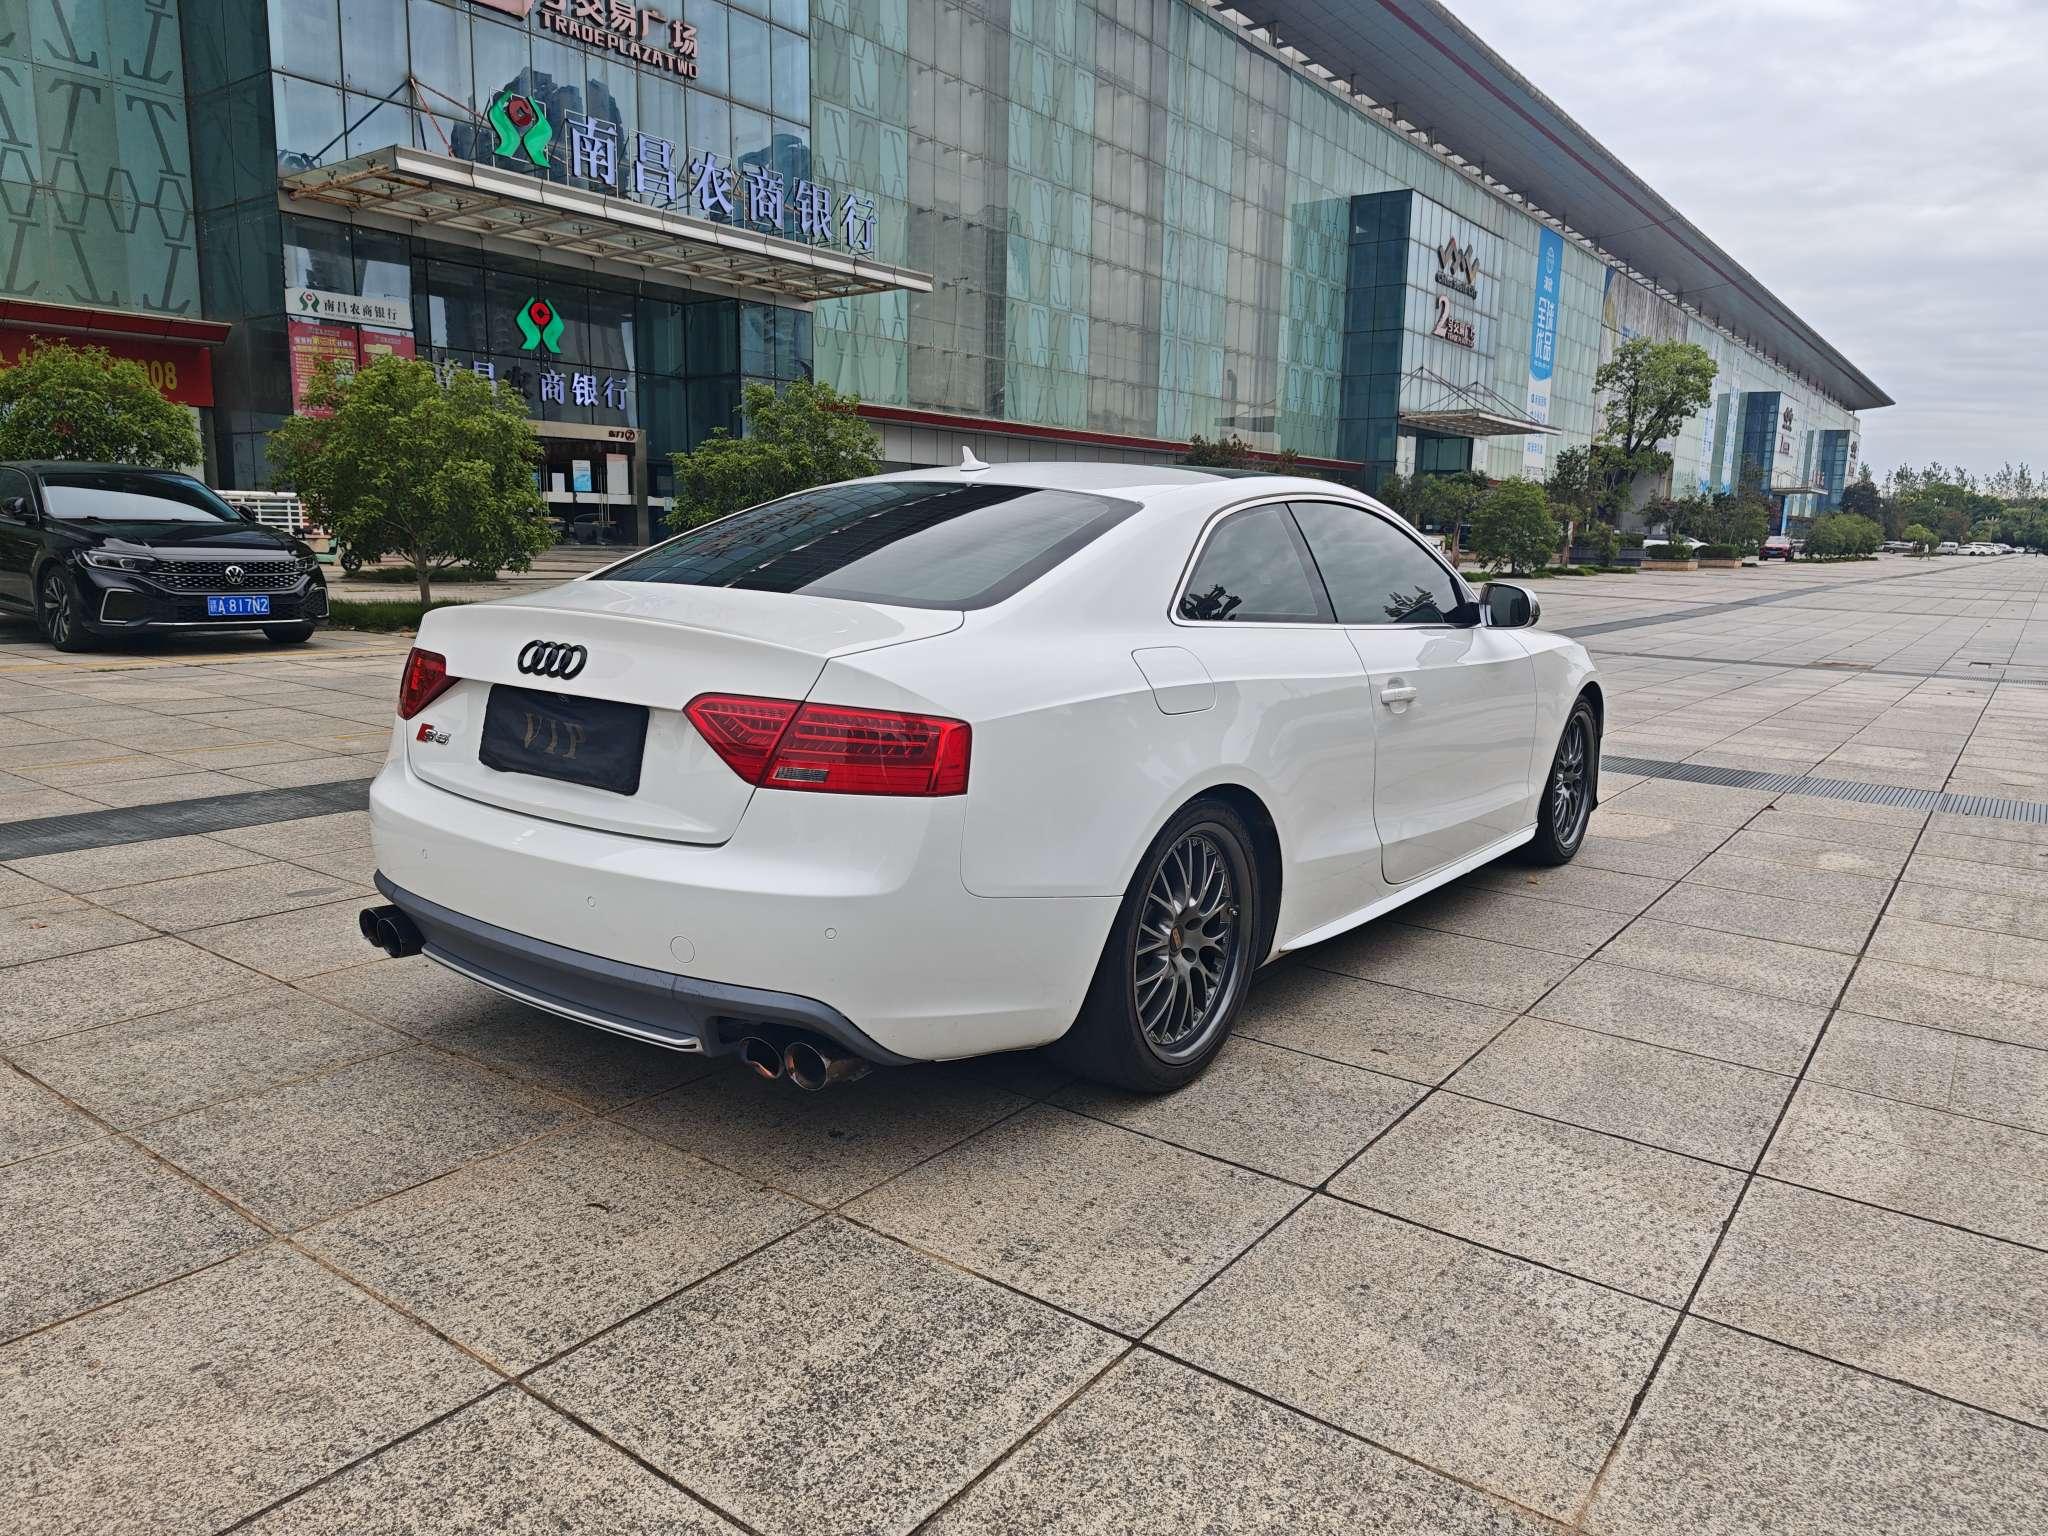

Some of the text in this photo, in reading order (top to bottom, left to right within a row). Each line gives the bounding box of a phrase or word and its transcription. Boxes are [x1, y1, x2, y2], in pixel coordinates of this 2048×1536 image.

[543, 0, 699, 58] 交易广场
[568, 116, 876, 250] 南昌农商银行
[324, 299, 399, 321] 南昌农商银行
[522, 711, 586, 760] VIP
